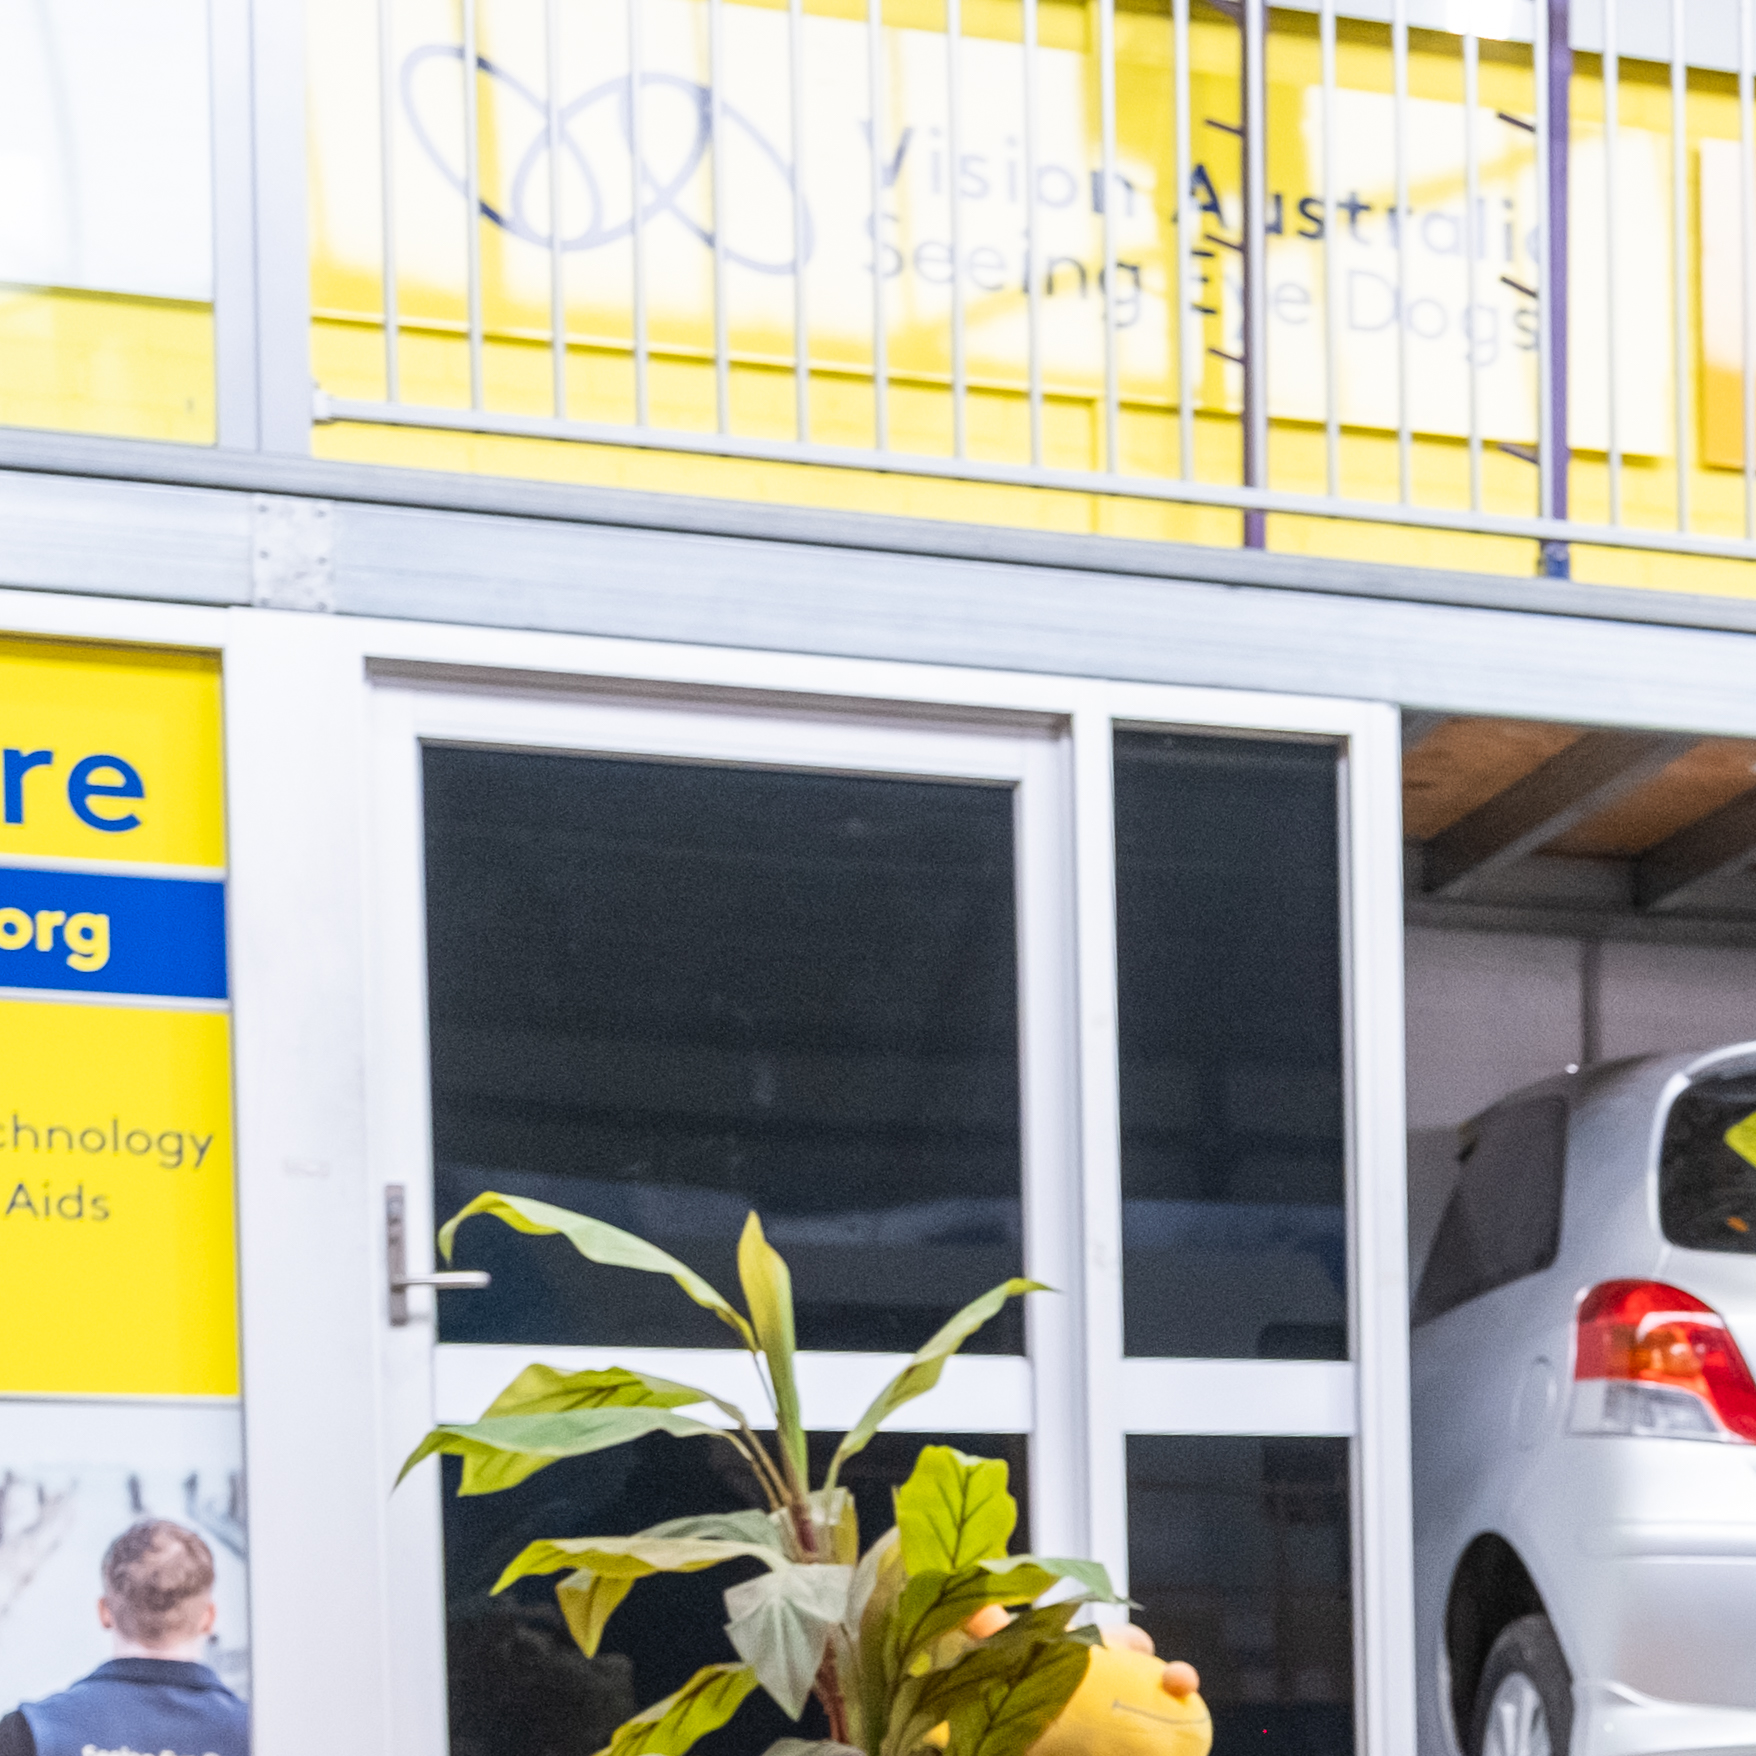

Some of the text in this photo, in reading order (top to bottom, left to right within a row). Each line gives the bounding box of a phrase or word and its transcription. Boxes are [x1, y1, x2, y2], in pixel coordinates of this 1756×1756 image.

[859, 118, 1136, 218] Vision
[864, 211, 1142, 329] Seeing
[0, 1113, 214, 1170] hnology
[6, 1182, 109, 1221] Aids
